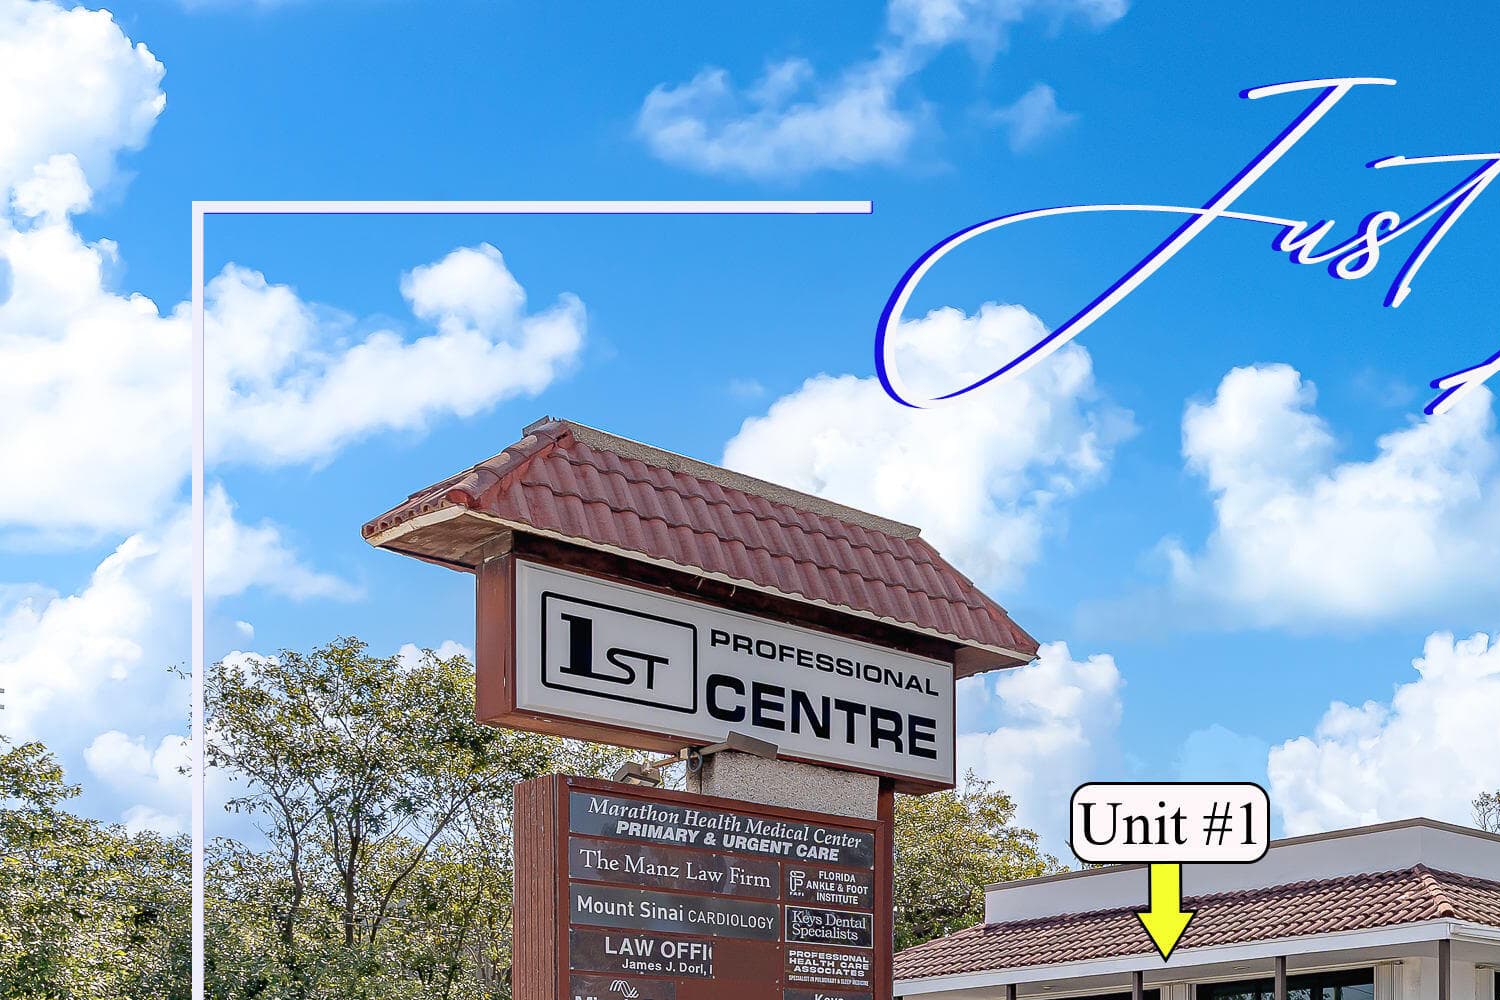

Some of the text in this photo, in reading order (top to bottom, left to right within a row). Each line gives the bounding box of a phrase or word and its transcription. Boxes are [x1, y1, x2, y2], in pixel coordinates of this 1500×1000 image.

[710, 628, 940, 697] PROFESSIONAL
[705, 673, 938, 760] CENTRE
[588, 797, 862, 848] Marathon Health Medical Center
[616, 820, 840, 861] PRIMARY & URGENT CARE
[579, 849, 771, 888] The Manz Law Firm
[819, 871, 856, 883] FLORIDA
[806, 880, 868, 895] ANKLE & FOOT
[816, 892, 859, 904] INSTITUTE
[577, 895, 775, 930] Mount Sinai CARDIOLOGY
[792, 910, 866, 929] Keys Dental
[792, 923, 859, 940] Specialists
[605, 936, 654, 957] LAW
[622, 958, 662, 972] James
[665, 961, 676, 972] J.
[789, 950, 869, 963] PROFESSIONAL
[789, 958, 869, 970] HEALTH CARE
[794, 966, 865, 977] ASSOCIATES
